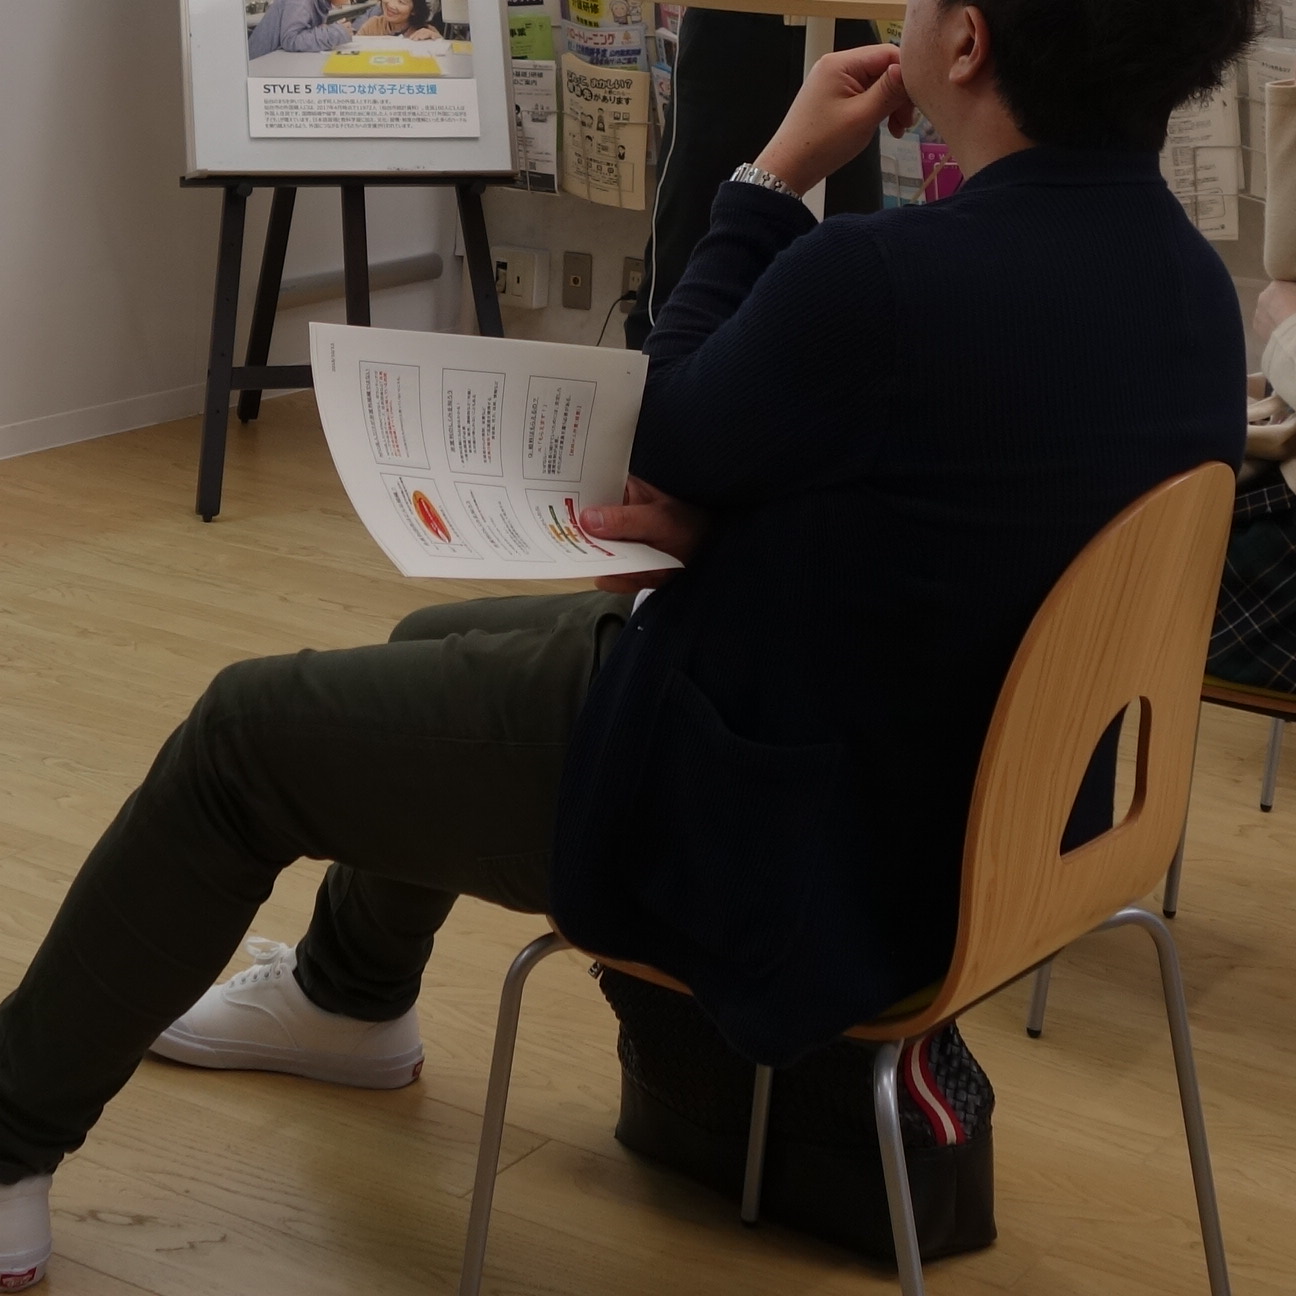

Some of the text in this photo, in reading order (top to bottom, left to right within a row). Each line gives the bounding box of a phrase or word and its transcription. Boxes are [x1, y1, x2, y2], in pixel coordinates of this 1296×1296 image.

[263, 83, 438, 95] STYLE 5 外国につながる子ども支援
